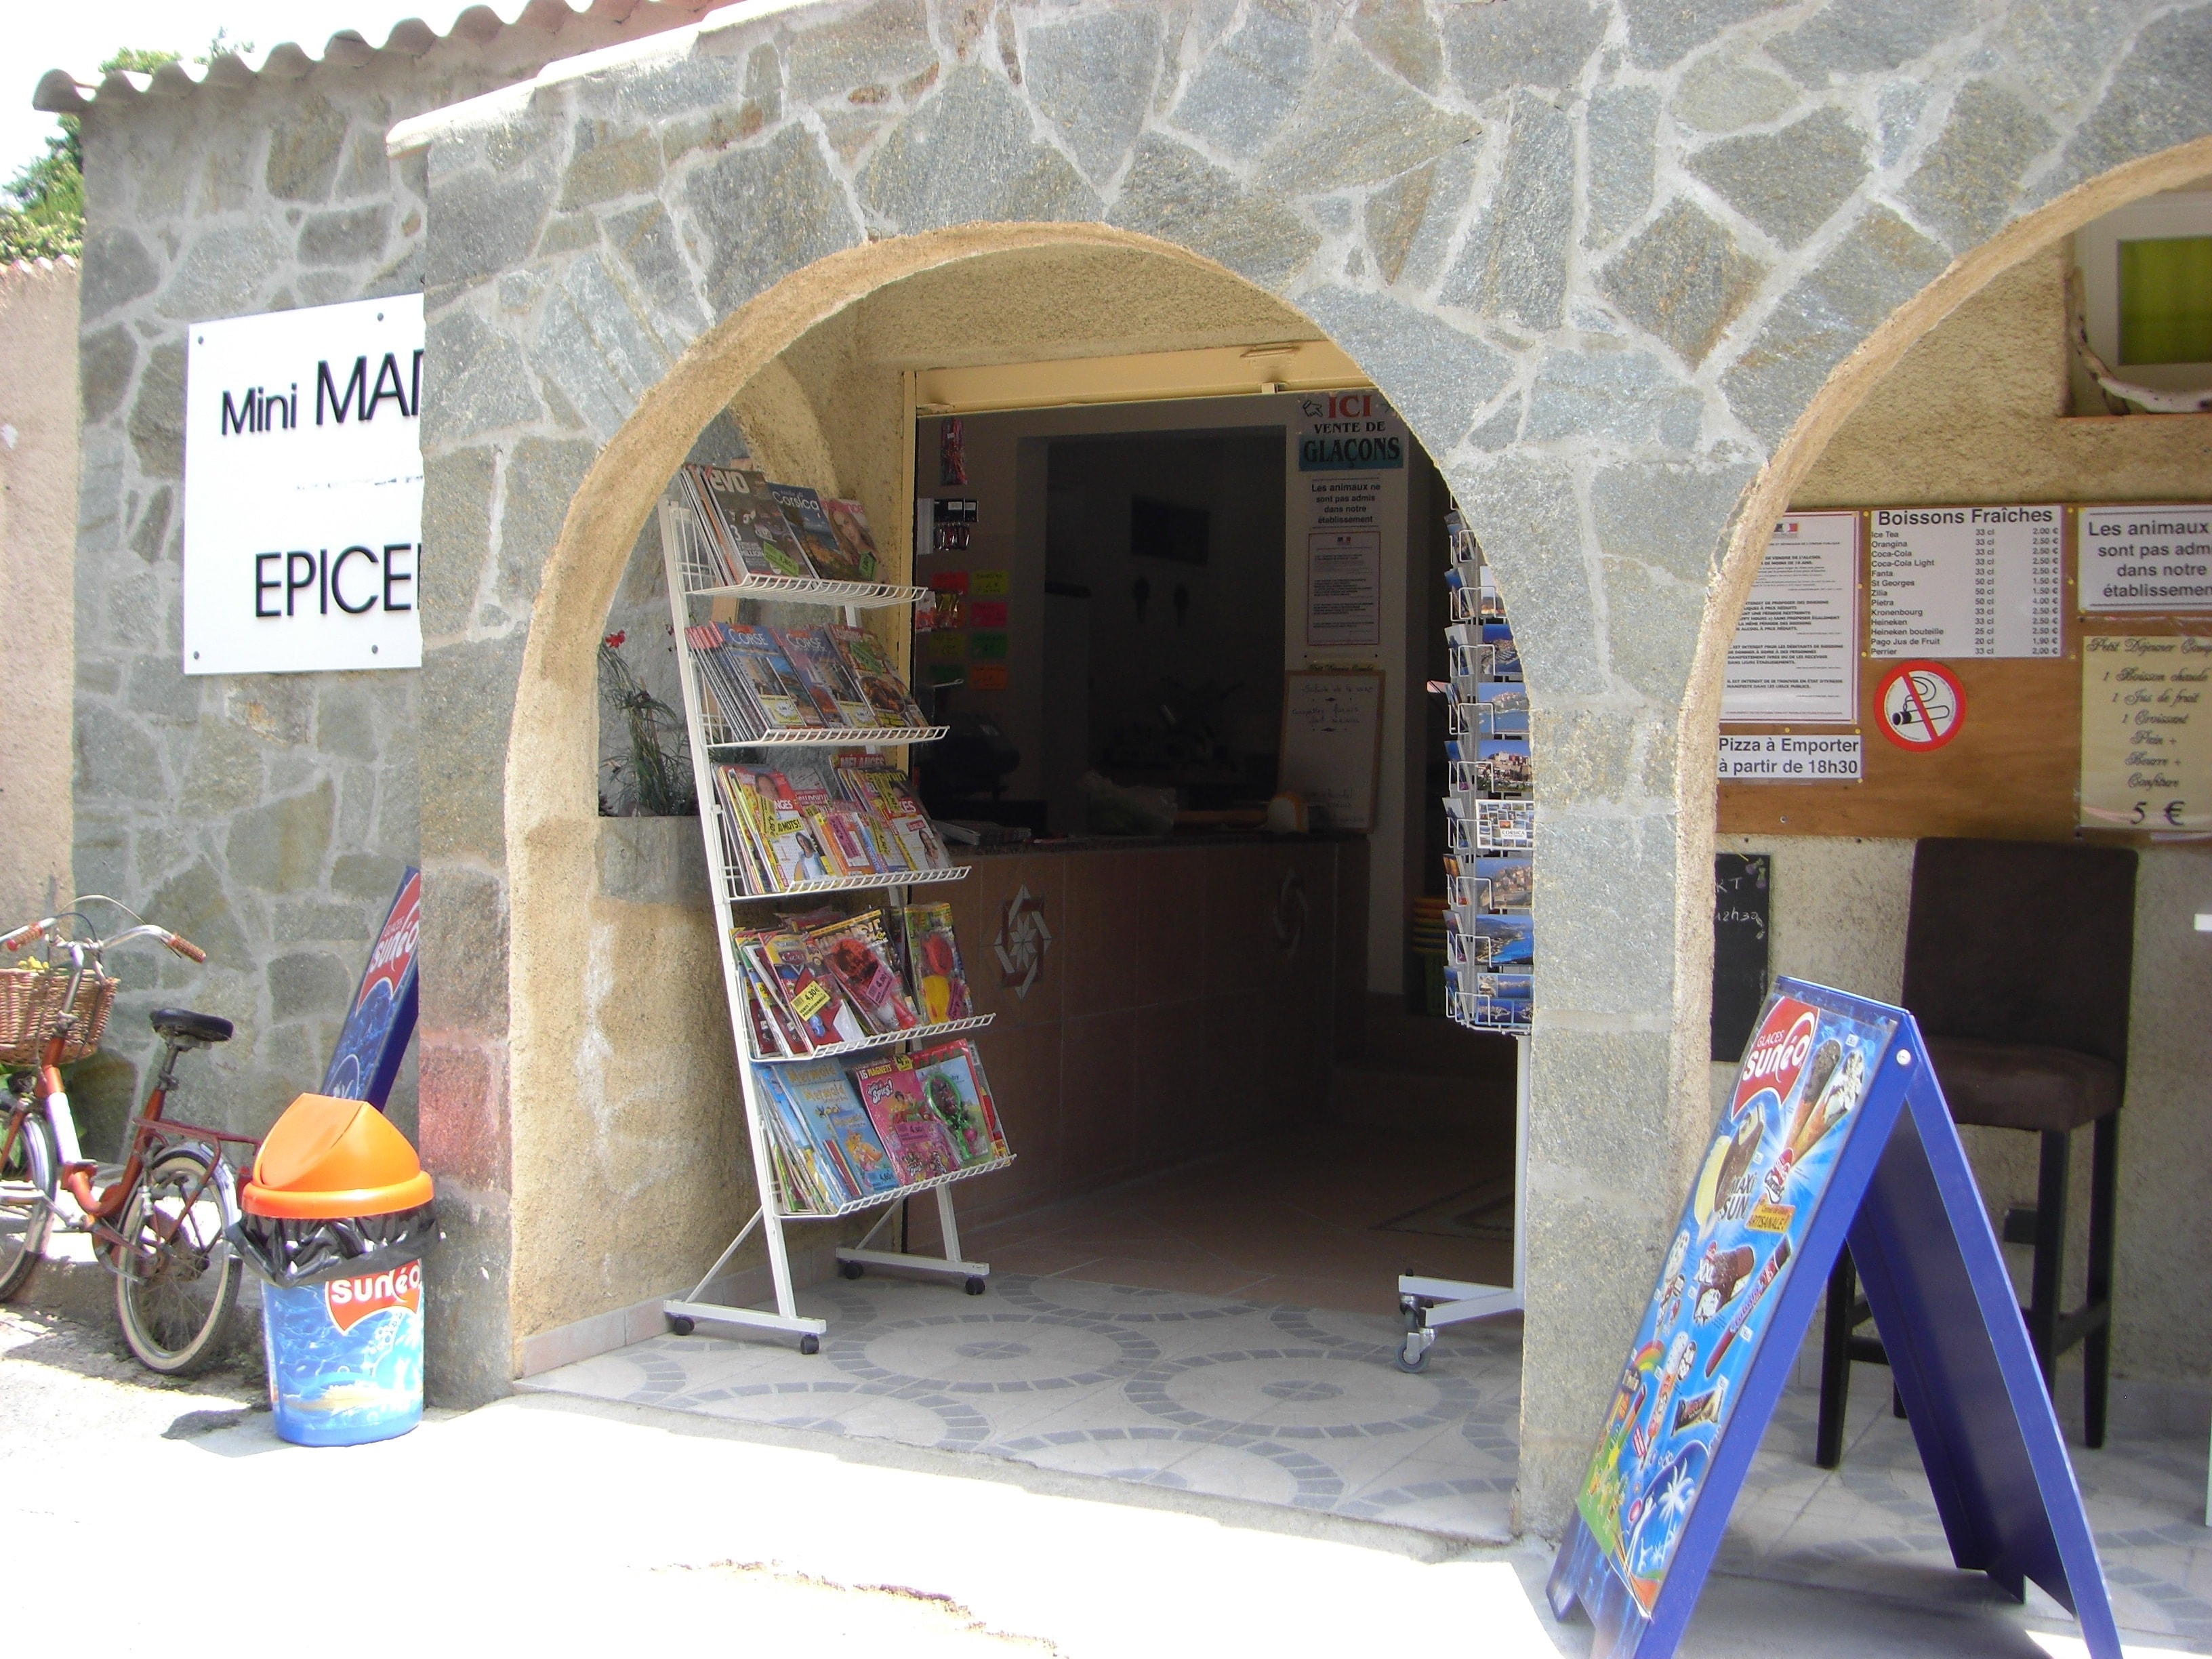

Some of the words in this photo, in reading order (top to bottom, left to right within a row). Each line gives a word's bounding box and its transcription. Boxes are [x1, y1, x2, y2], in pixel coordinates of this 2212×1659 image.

[222, 382, 298, 436] Mini
[1328, 394, 1372, 418] ICI
[1314, 422, 1361, 434] VENTE
[1366, 422, 1386, 432] DE
[1303, 437, 1400, 468] GLAÇONS
[1312, 484, 1327, 492] Les
[1329, 483, 1368, 492] animaux
[1351, 494, 1376, 502] admis
[1317, 515, 1373, 524] établissement
[1879, 511, 1965, 525] Boissons
[1971, 507, 2053, 523] Fraîches
[2089, 522, 2121, 536] Les
[2128, 520, 2209, 535] animaux
[2098, 544, 2134, 557] sont
[2139, 545, 2169, 559] pas
[2175, 542, 2212, 555] adm
[2117, 564, 2156, 577] dans
[2163, 563, 2207, 575] notre
[255, 542, 422, 618] EPICE
[1871, 609, 1923, 617] Kronenbourg
[1871, 638, 1891, 647] Pago
[2104, 672, 2110, 681] 1
[2112, 693, 2118, 703] 1
[2124, 689, 2152, 705] Jus
[2157, 688, 2173, 703] de
[2170, 689, 2200, 707] fruit
[2122, 714, 2128, 723] 1
[1719, 737, 1760, 752] Pizza
[1766, 737, 1775, 752] à
[1781, 737, 1858, 755] Emporter
[2130, 730, 2163, 745] Pain
[1719, 758, 1727, 772] à
[1734, 759, 1778, 775] partir
[1782, 760, 1803, 773] de
[1809, 760, 1858, 773] 18h30
[2131, 800, 2147, 825] 5
[2163, 800, 2186, 826] €
[1757, 1029, 1784, 1047] GLACES
[1742, 1033, 1810, 1082] sunéo
[1731, 1172, 1757, 1194] MAXI
[1719, 1195, 1749, 1221] SUN
[331, 1265, 420, 1304] sunéo
